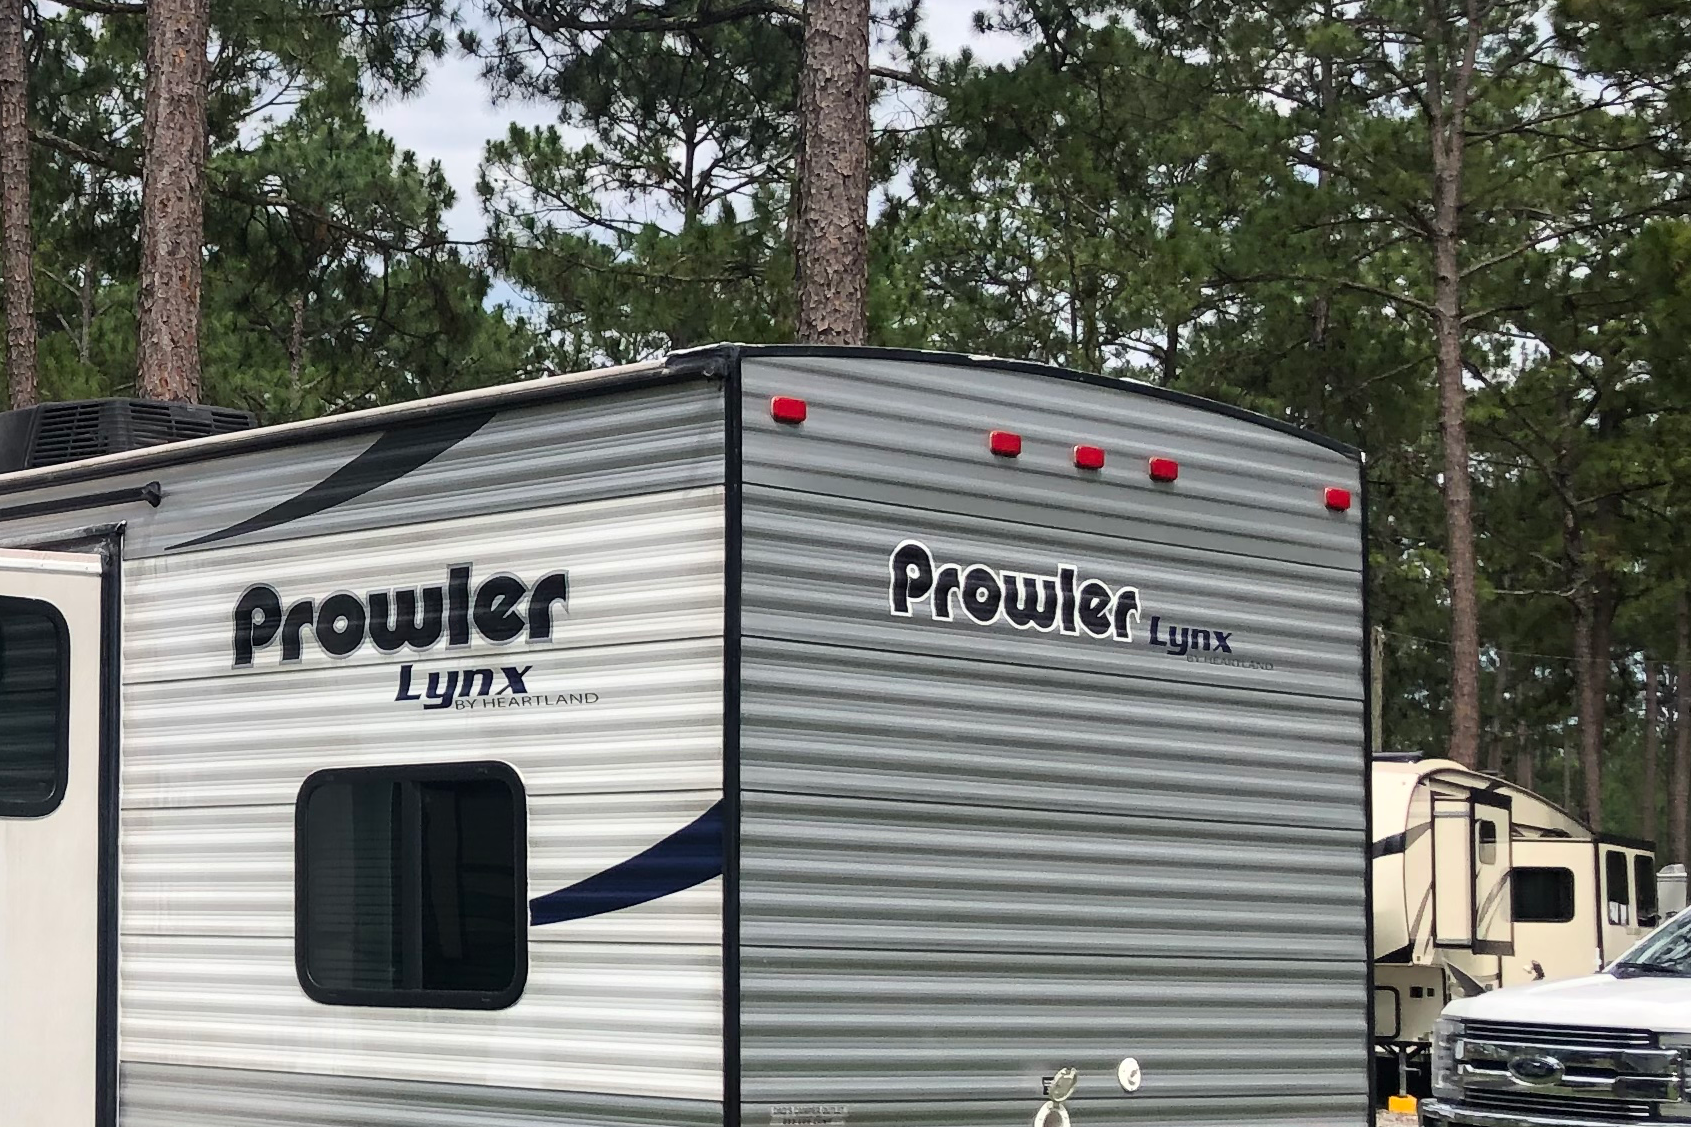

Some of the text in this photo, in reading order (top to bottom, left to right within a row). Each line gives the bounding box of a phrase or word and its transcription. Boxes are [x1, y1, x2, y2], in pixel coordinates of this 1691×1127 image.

[231, 561, 570, 670] Prowler
[888, 538, 1233, 656] Prowler Lynx
[394, 663, 534, 710] Lynx
[454, 692, 600, 711] BY HEARTLAND
